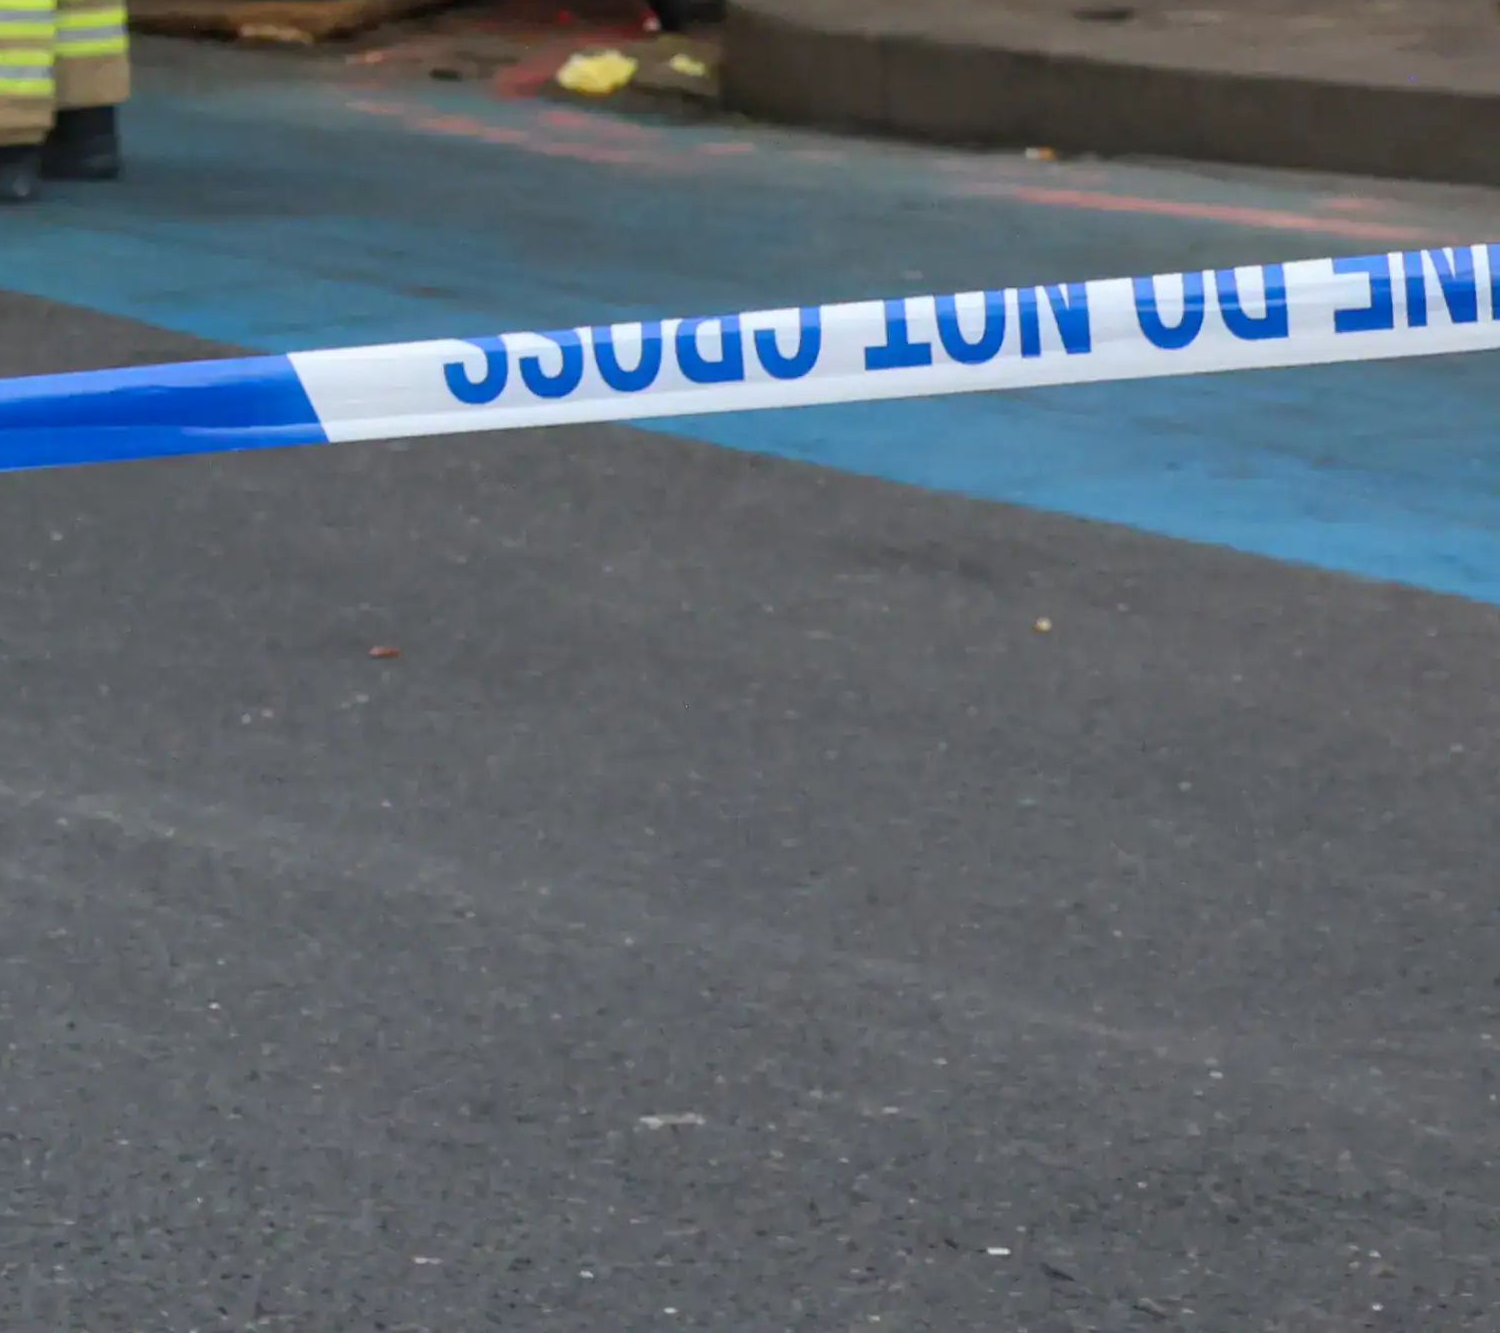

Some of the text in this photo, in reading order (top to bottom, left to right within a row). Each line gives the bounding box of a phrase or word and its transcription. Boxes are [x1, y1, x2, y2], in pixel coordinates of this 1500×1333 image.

[865, 281, 1094, 372] NOT
[1132, 263, 1290, 349] DO
[443, 305, 822, 404] CROSS
